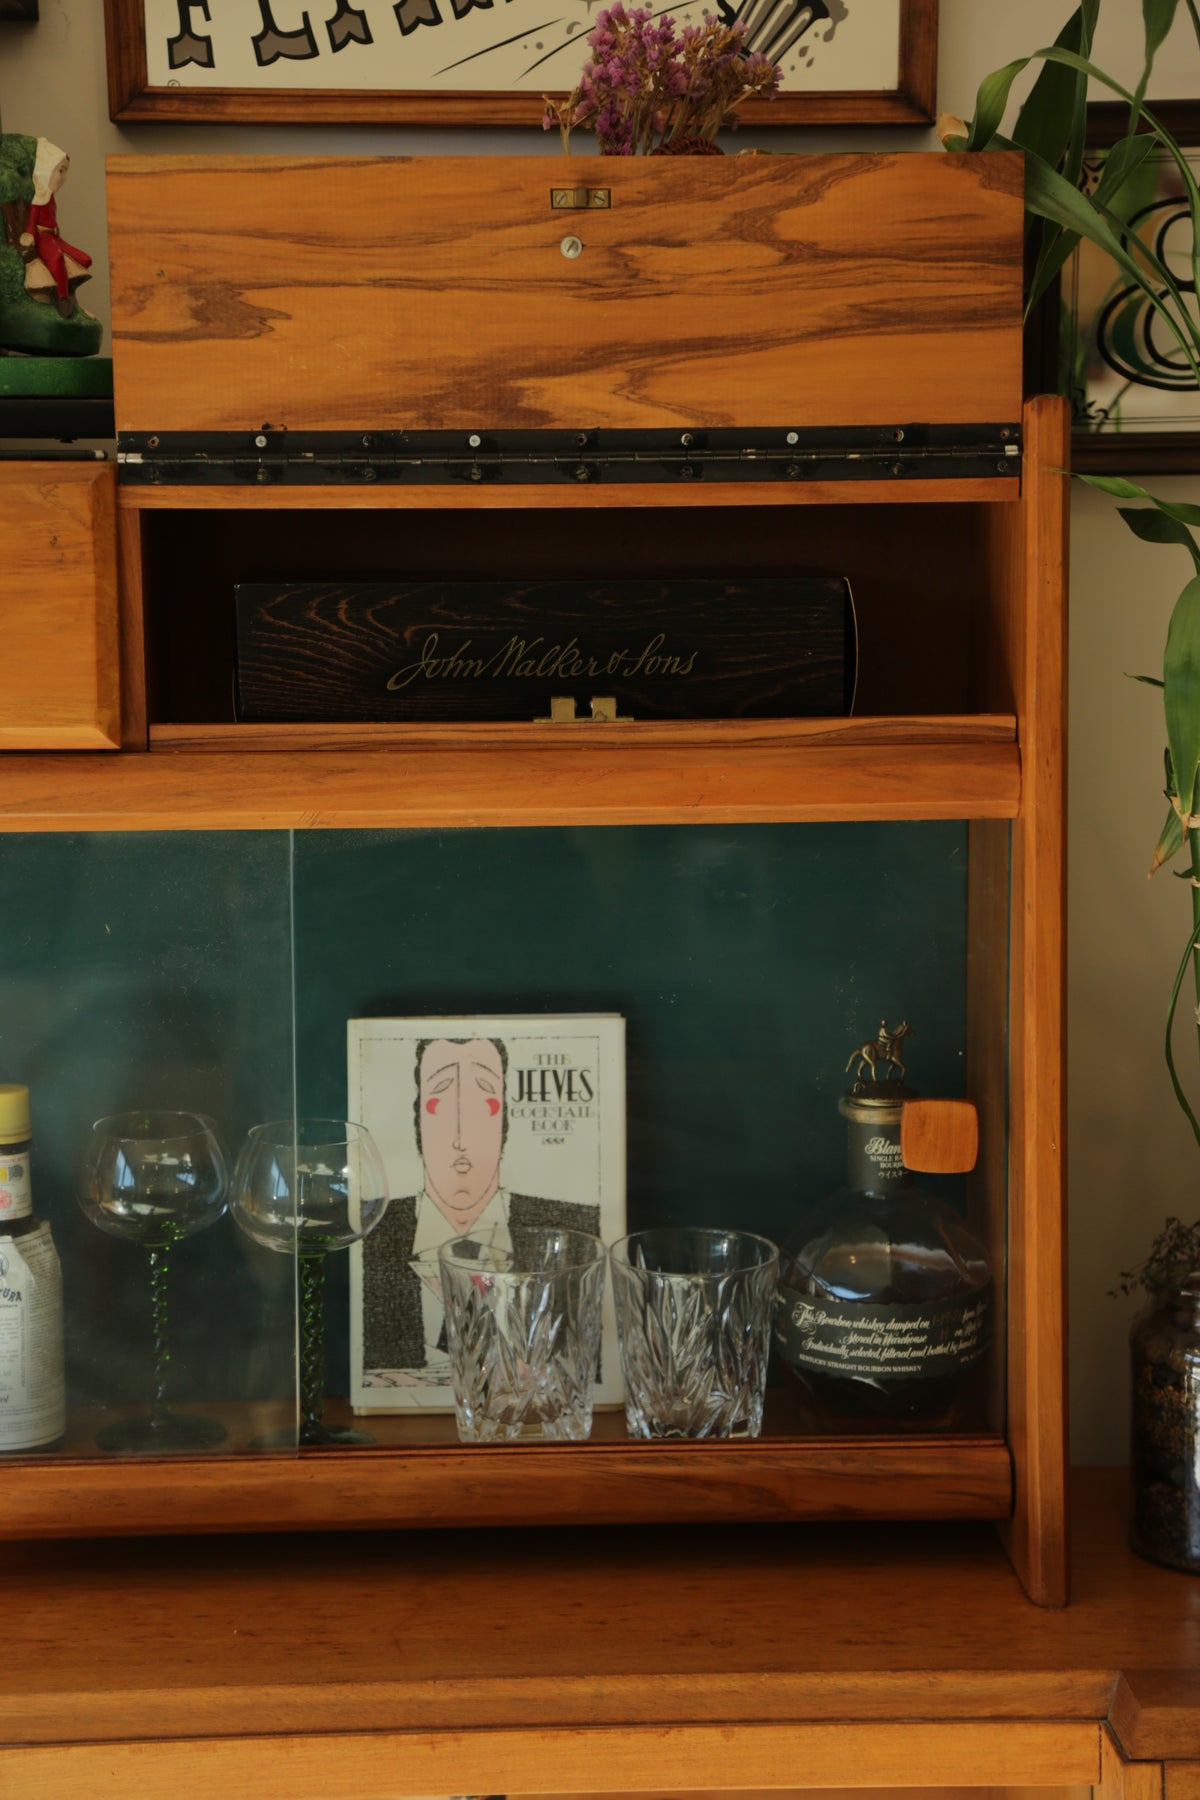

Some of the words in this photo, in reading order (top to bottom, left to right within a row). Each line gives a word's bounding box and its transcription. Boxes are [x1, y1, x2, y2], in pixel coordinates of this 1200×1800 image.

[387, 632, 490, 690] John
[492, 634, 602, 678] Walker
[624, 632, 699, 677] Sons
[533, 1053, 571, 1066] THE
[511, 1068, 594, 1103] JEEVES
[510, 1106, 596, 1118] COCKTAIL
[531, 1119, 574, 1132] BOOK
[864, 1137, 902, 1155] Blan
[827, 1361, 857, 1371] STRAIGHT
[857, 1364, 892, 1372] BOURBON
[892, 1364, 922, 1373] WHISKEY
